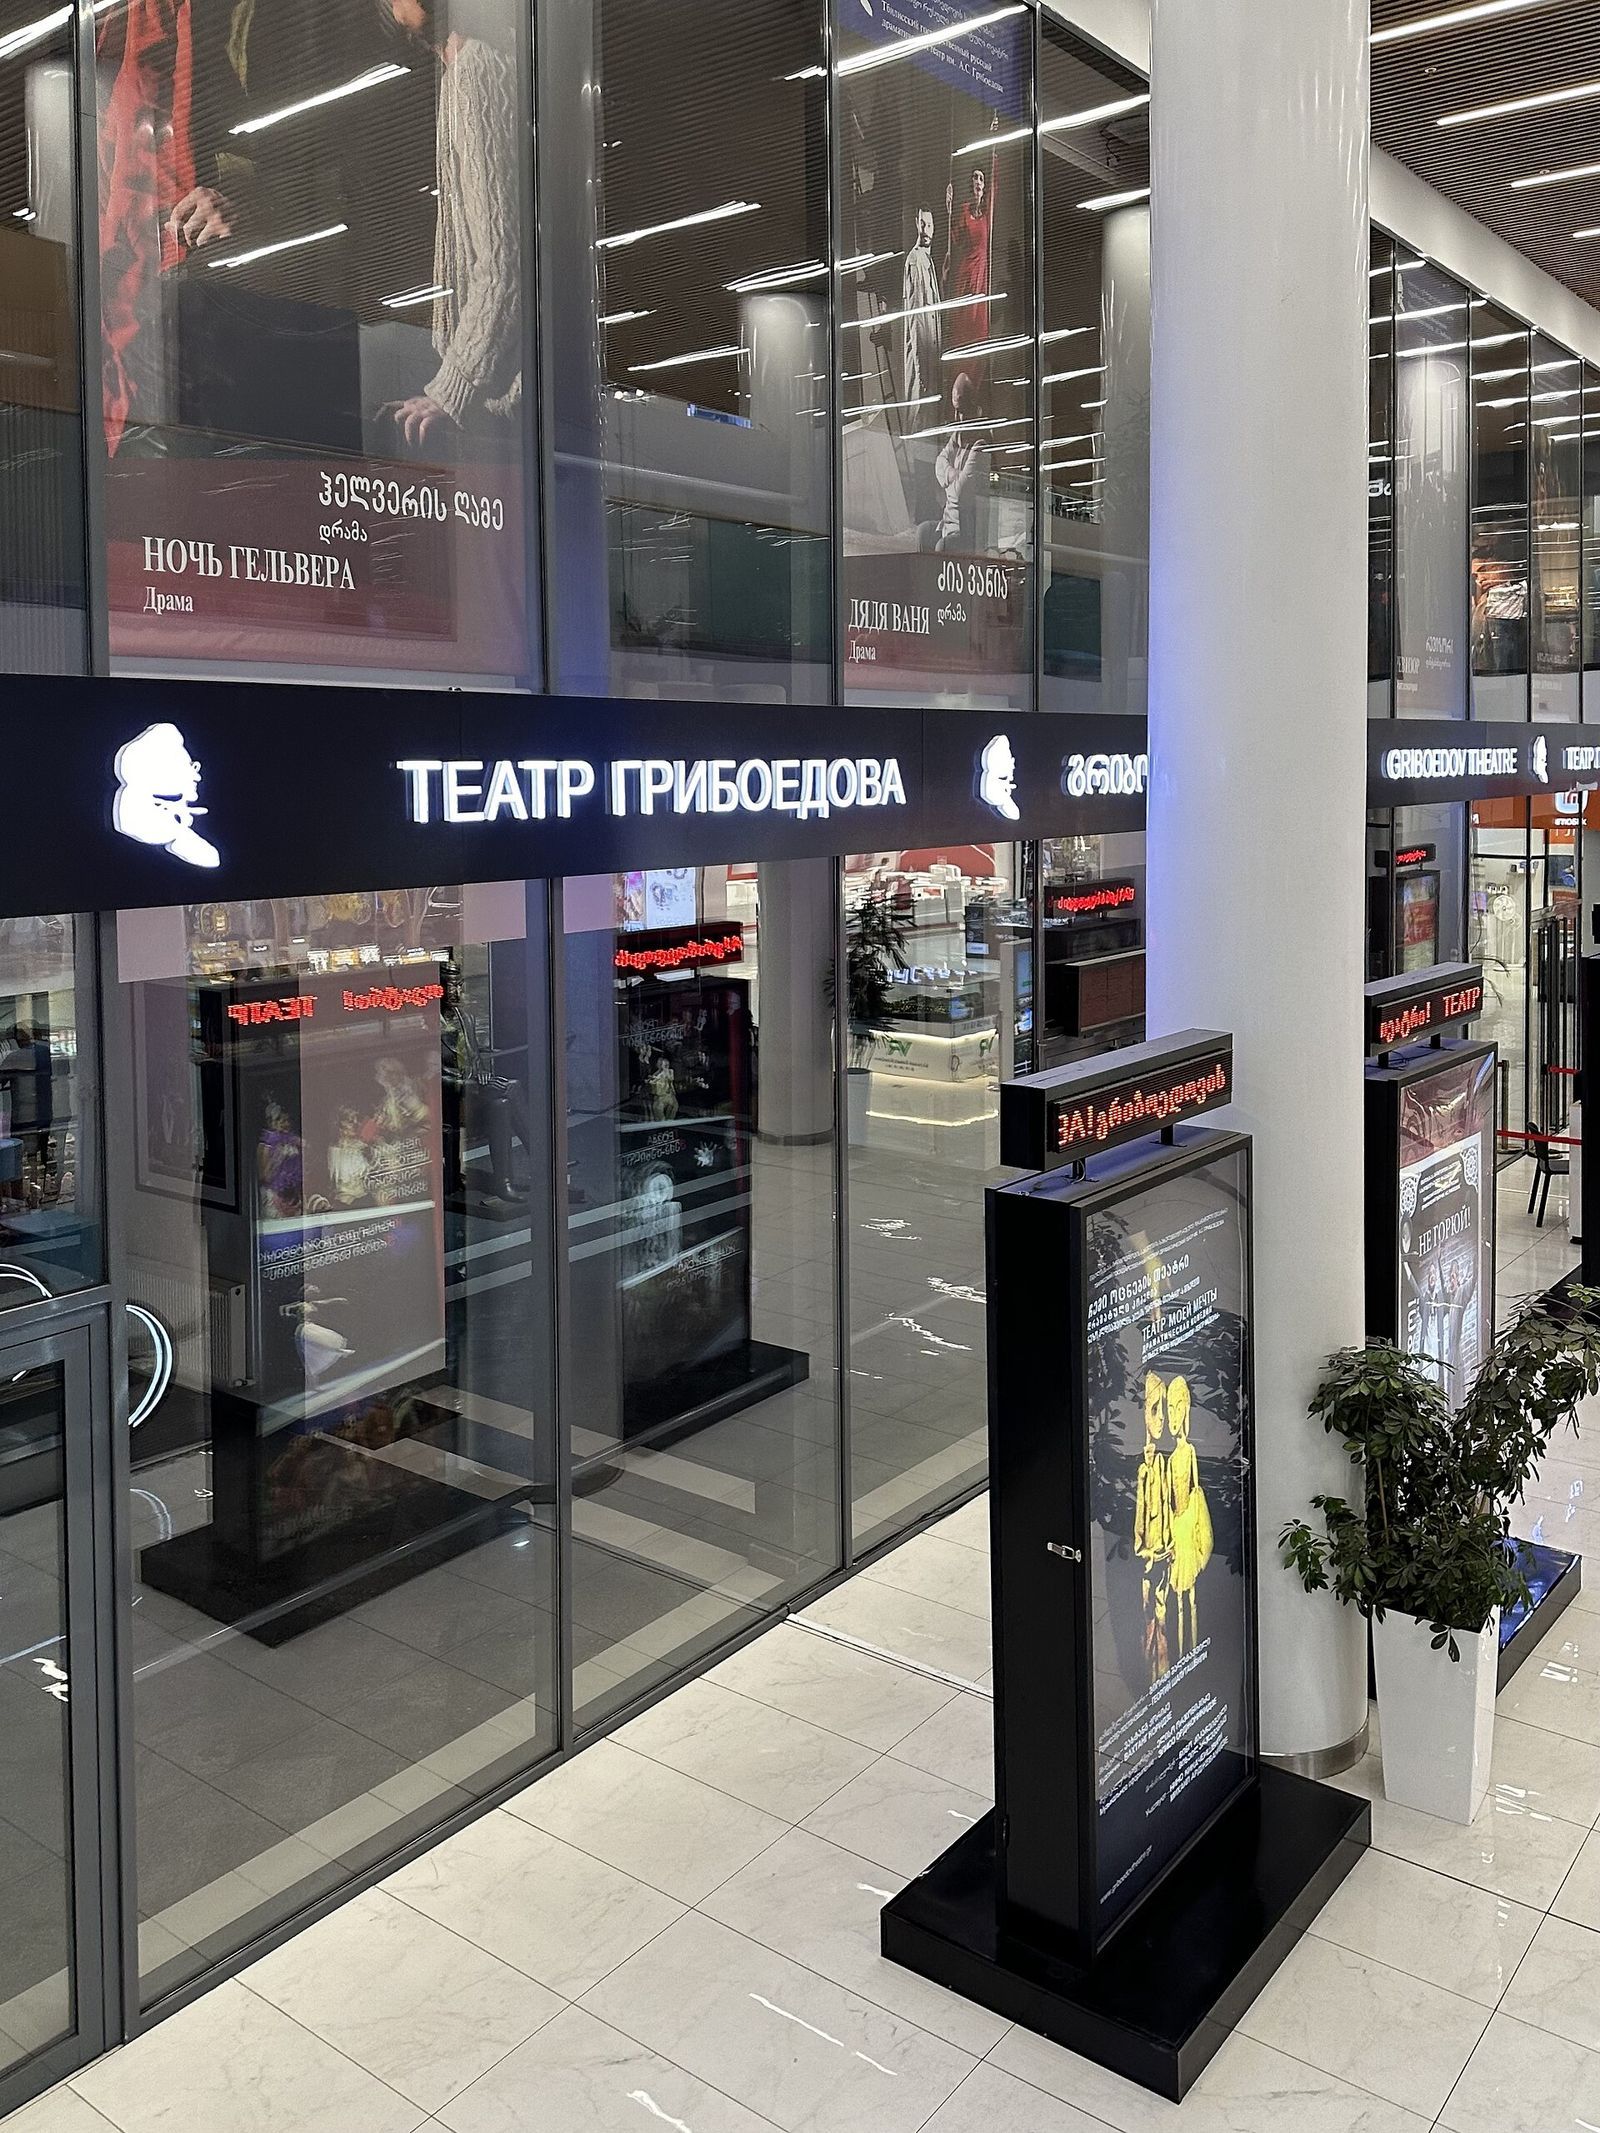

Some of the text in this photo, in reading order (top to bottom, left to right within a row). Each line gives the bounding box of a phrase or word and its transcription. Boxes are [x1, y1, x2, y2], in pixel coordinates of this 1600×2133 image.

[318, 471, 504, 531] ჰელვერის ღამე
[318, 518, 368, 544] დრამა
[141, 536, 356, 590] НОЧЬ ГЕЛЬВЕРА
[937, 561, 1009, 599] ძია ვანია
[143, 586, 194, 615] Драма
[848, 598, 930, 635] ДЯДЯ ВАНЯ
[937, 602, 967, 626] დრამა
[848, 640, 877, 663] Драма
[1384, 747, 1518, 780] GRIBOEDOV THEATRE
[1564, 746, 1594, 771] ТЕАТР
[396, 758, 907, 824] ТЕАТР ГРИБОЕДОВА
[1442, 986, 1481, 1017] ТЕАТР
[1418, 1205, 1471, 1257] НЕ ГОРЮЙ!
[1153, 1254, 1190, 1282] თეატრი
[1142, 1317, 1166, 1342] ТЕАТР
[1168, 1301, 1192, 1327] МОЕЙ
[1192, 1287, 1218, 1314] МЕЧТЫ
[1142, 1321, 1190, 1355] ДРАМАТИЧЕСКАЯ
